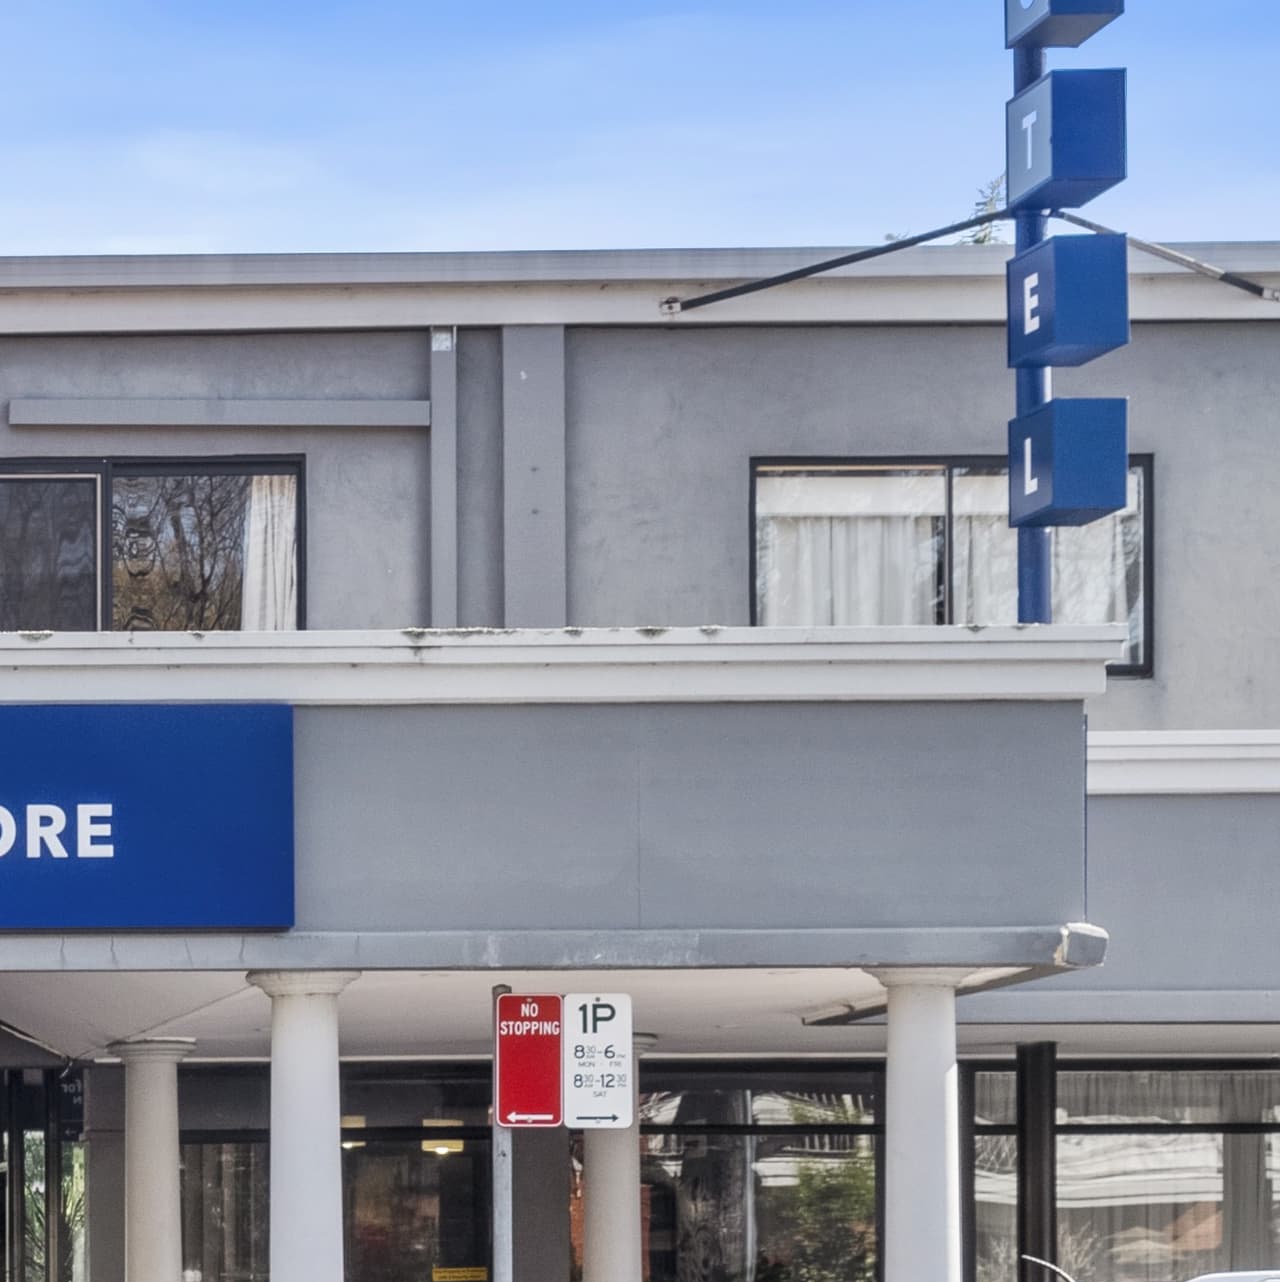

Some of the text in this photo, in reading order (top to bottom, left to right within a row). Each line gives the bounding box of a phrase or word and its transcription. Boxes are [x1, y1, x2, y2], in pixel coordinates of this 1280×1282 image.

[520, 1003, 539, 1018] NO
[578, 1003, 616, 1034] 1P
[500, 1020, 561, 1036] STOPPING
